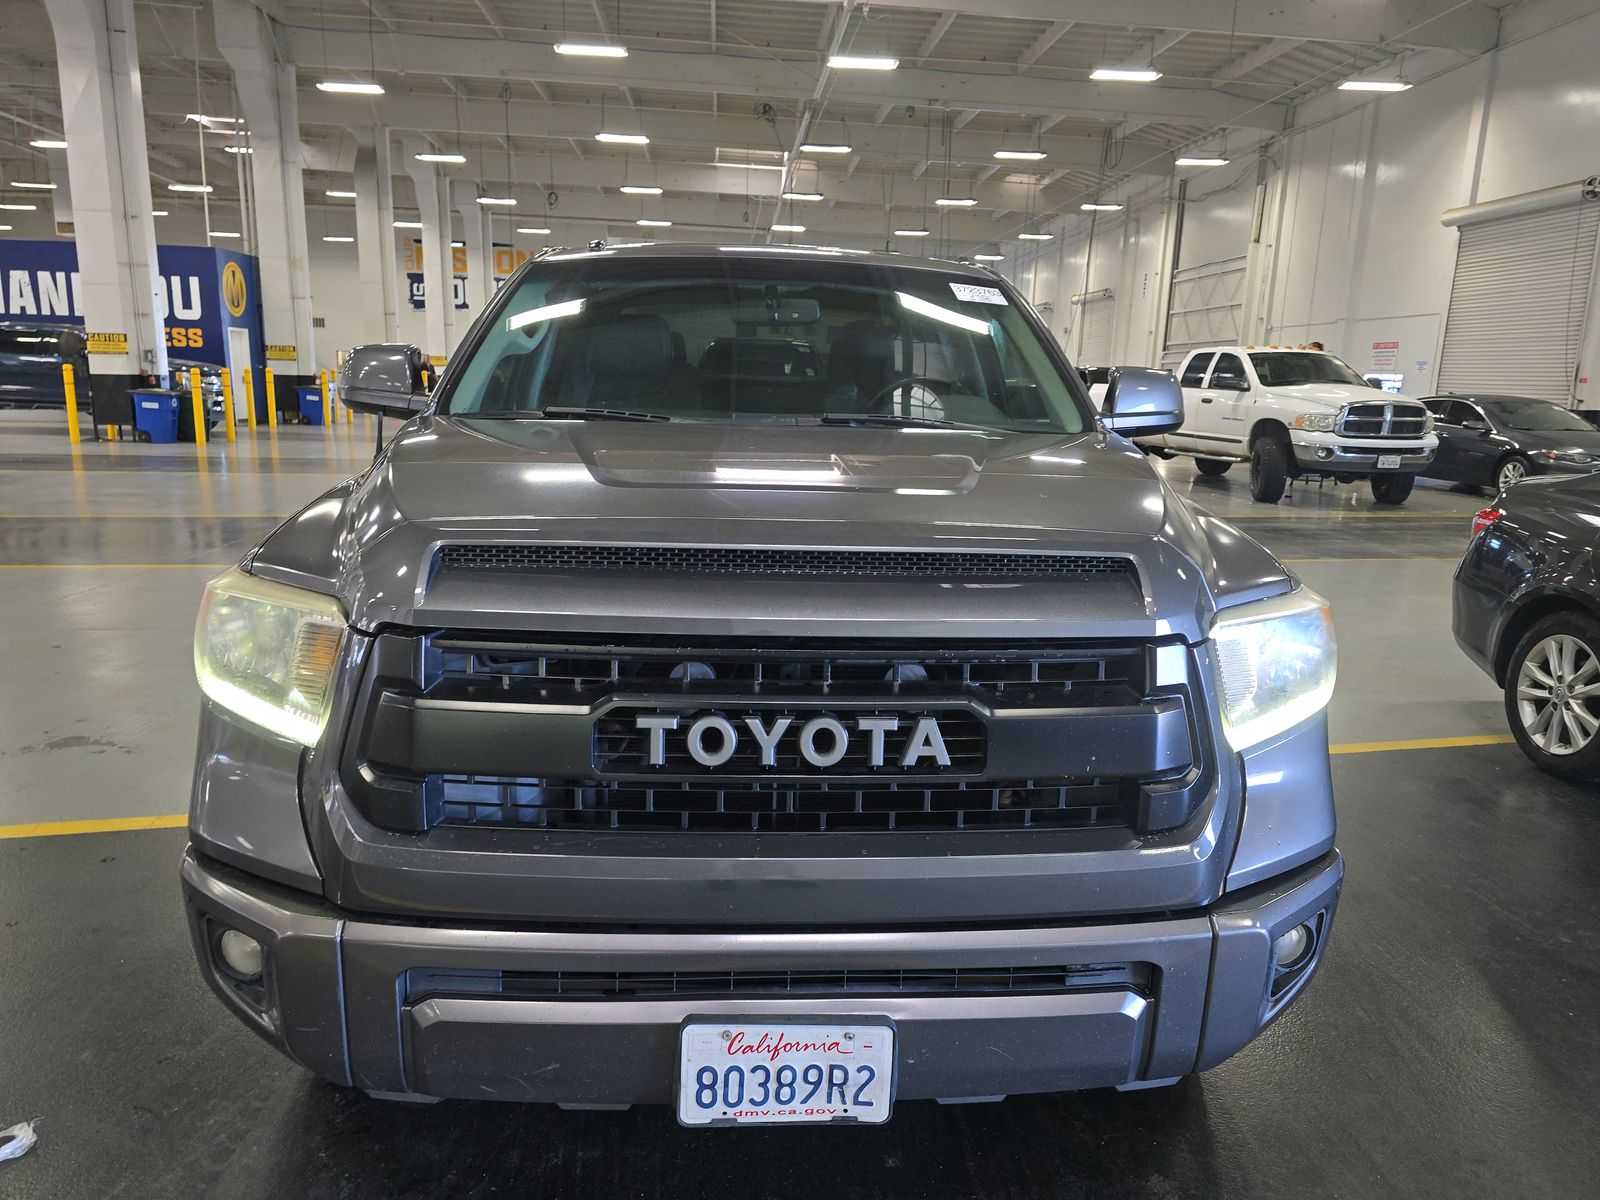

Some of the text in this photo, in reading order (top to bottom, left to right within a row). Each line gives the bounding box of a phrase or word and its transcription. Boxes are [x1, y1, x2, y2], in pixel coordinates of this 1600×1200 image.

[88, 333, 125, 342] CAUTION
[635, 714, 952, 767] TOYOTA
[727, 1031, 853, 1062] California
[695, 1063, 876, 1109] 80389R2
[733, 1108, 837, 1118] dmv.ca.gov
